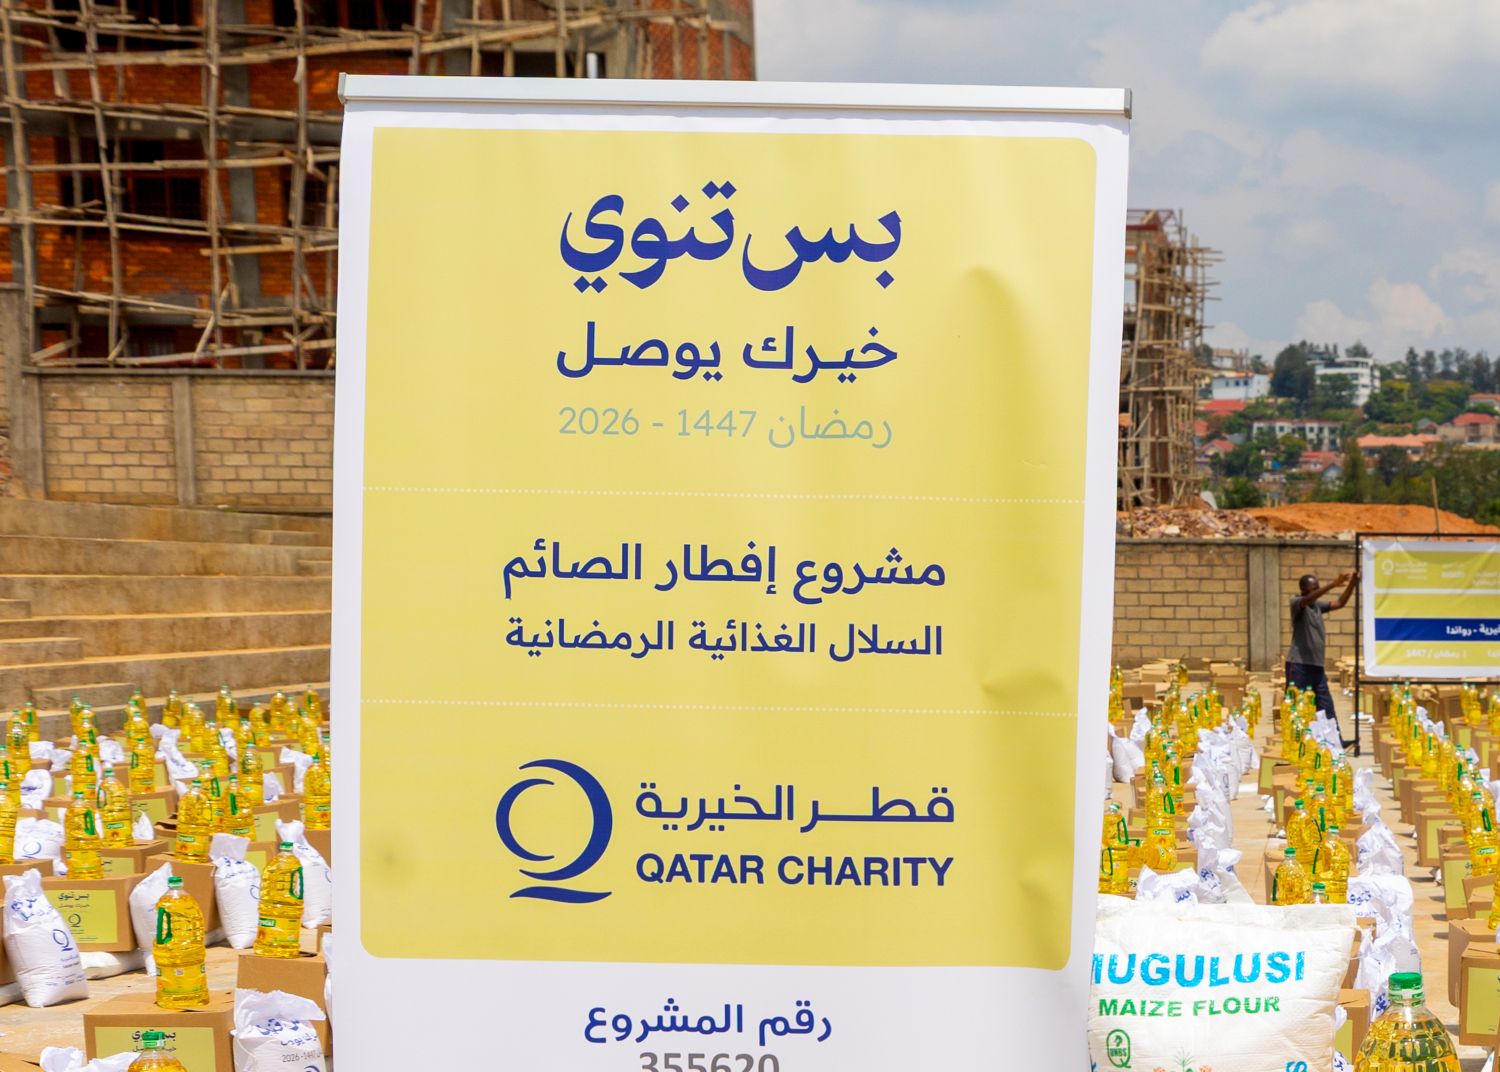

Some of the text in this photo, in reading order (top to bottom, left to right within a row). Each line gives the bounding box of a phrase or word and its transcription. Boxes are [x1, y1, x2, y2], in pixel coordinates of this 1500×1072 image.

[559, 181, 903, 293] بس تنوي
[556, 322, 898, 384] خيرك يوصل
[559, 406, 640, 437] 2026
[676, 409, 756, 439] 1447
[768, 406, 894, 450] رمضان
[503, 538, 946, 606] مشروع إفطار الصائم
[505, 617, 943, 662] السلال الغذائية الرمضانية
[635, 782, 955, 832] قطر الخيرية
[635, 854, 955, 888] QATAR CHARITY
[583, 998, 833, 1046] رقم المشروع
[1099, 997, 1280, 1017] MAIZE FLOUR
